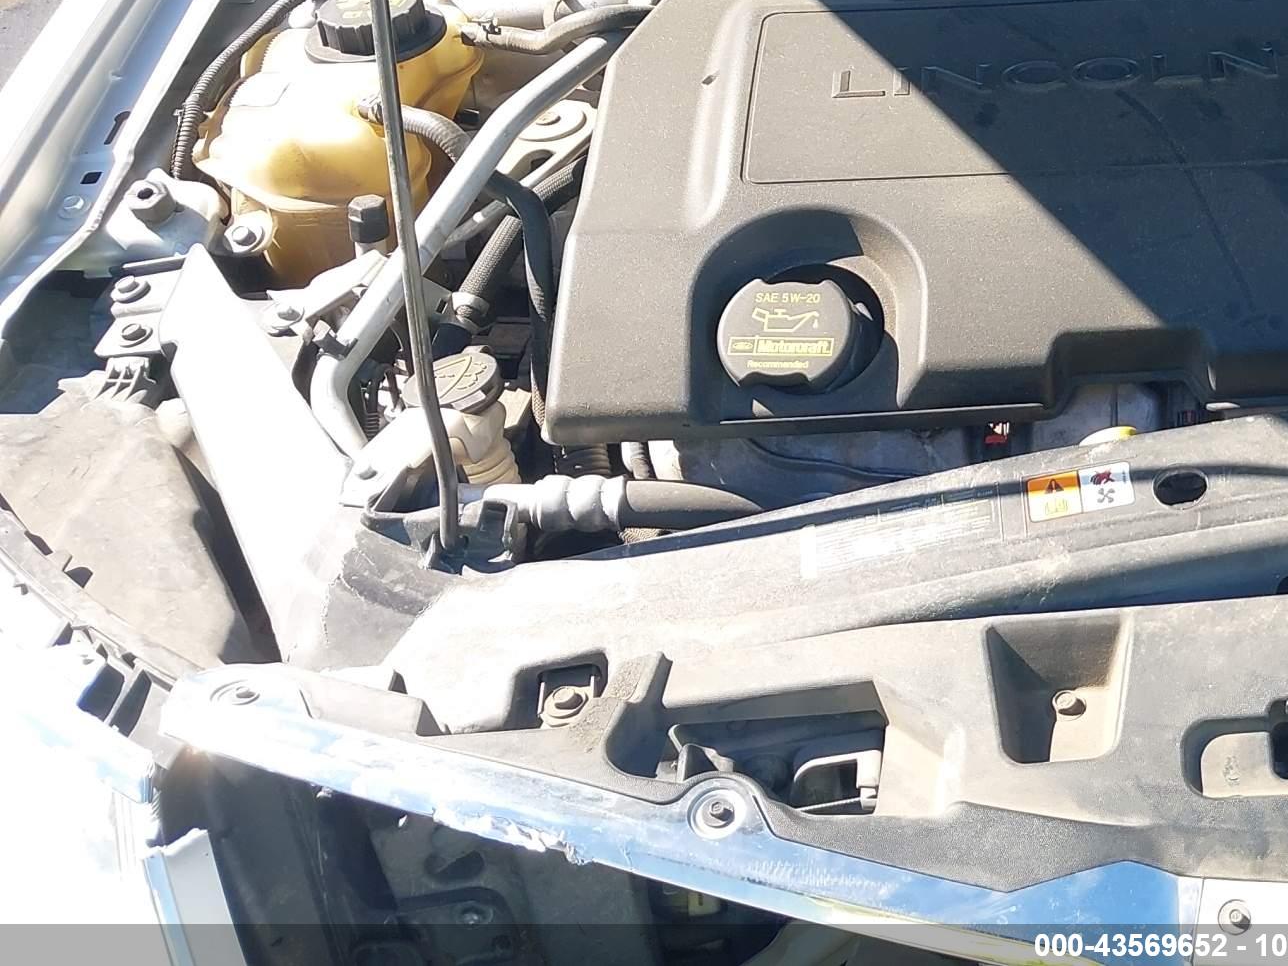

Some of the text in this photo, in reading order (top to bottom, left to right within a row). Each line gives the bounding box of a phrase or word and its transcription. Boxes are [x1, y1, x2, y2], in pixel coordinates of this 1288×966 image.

[832, 42, 1279, 98] LINCOLN
[755, 292, 820, 303] SAE 5W-20
[747, 360, 809, 368] Recommended
